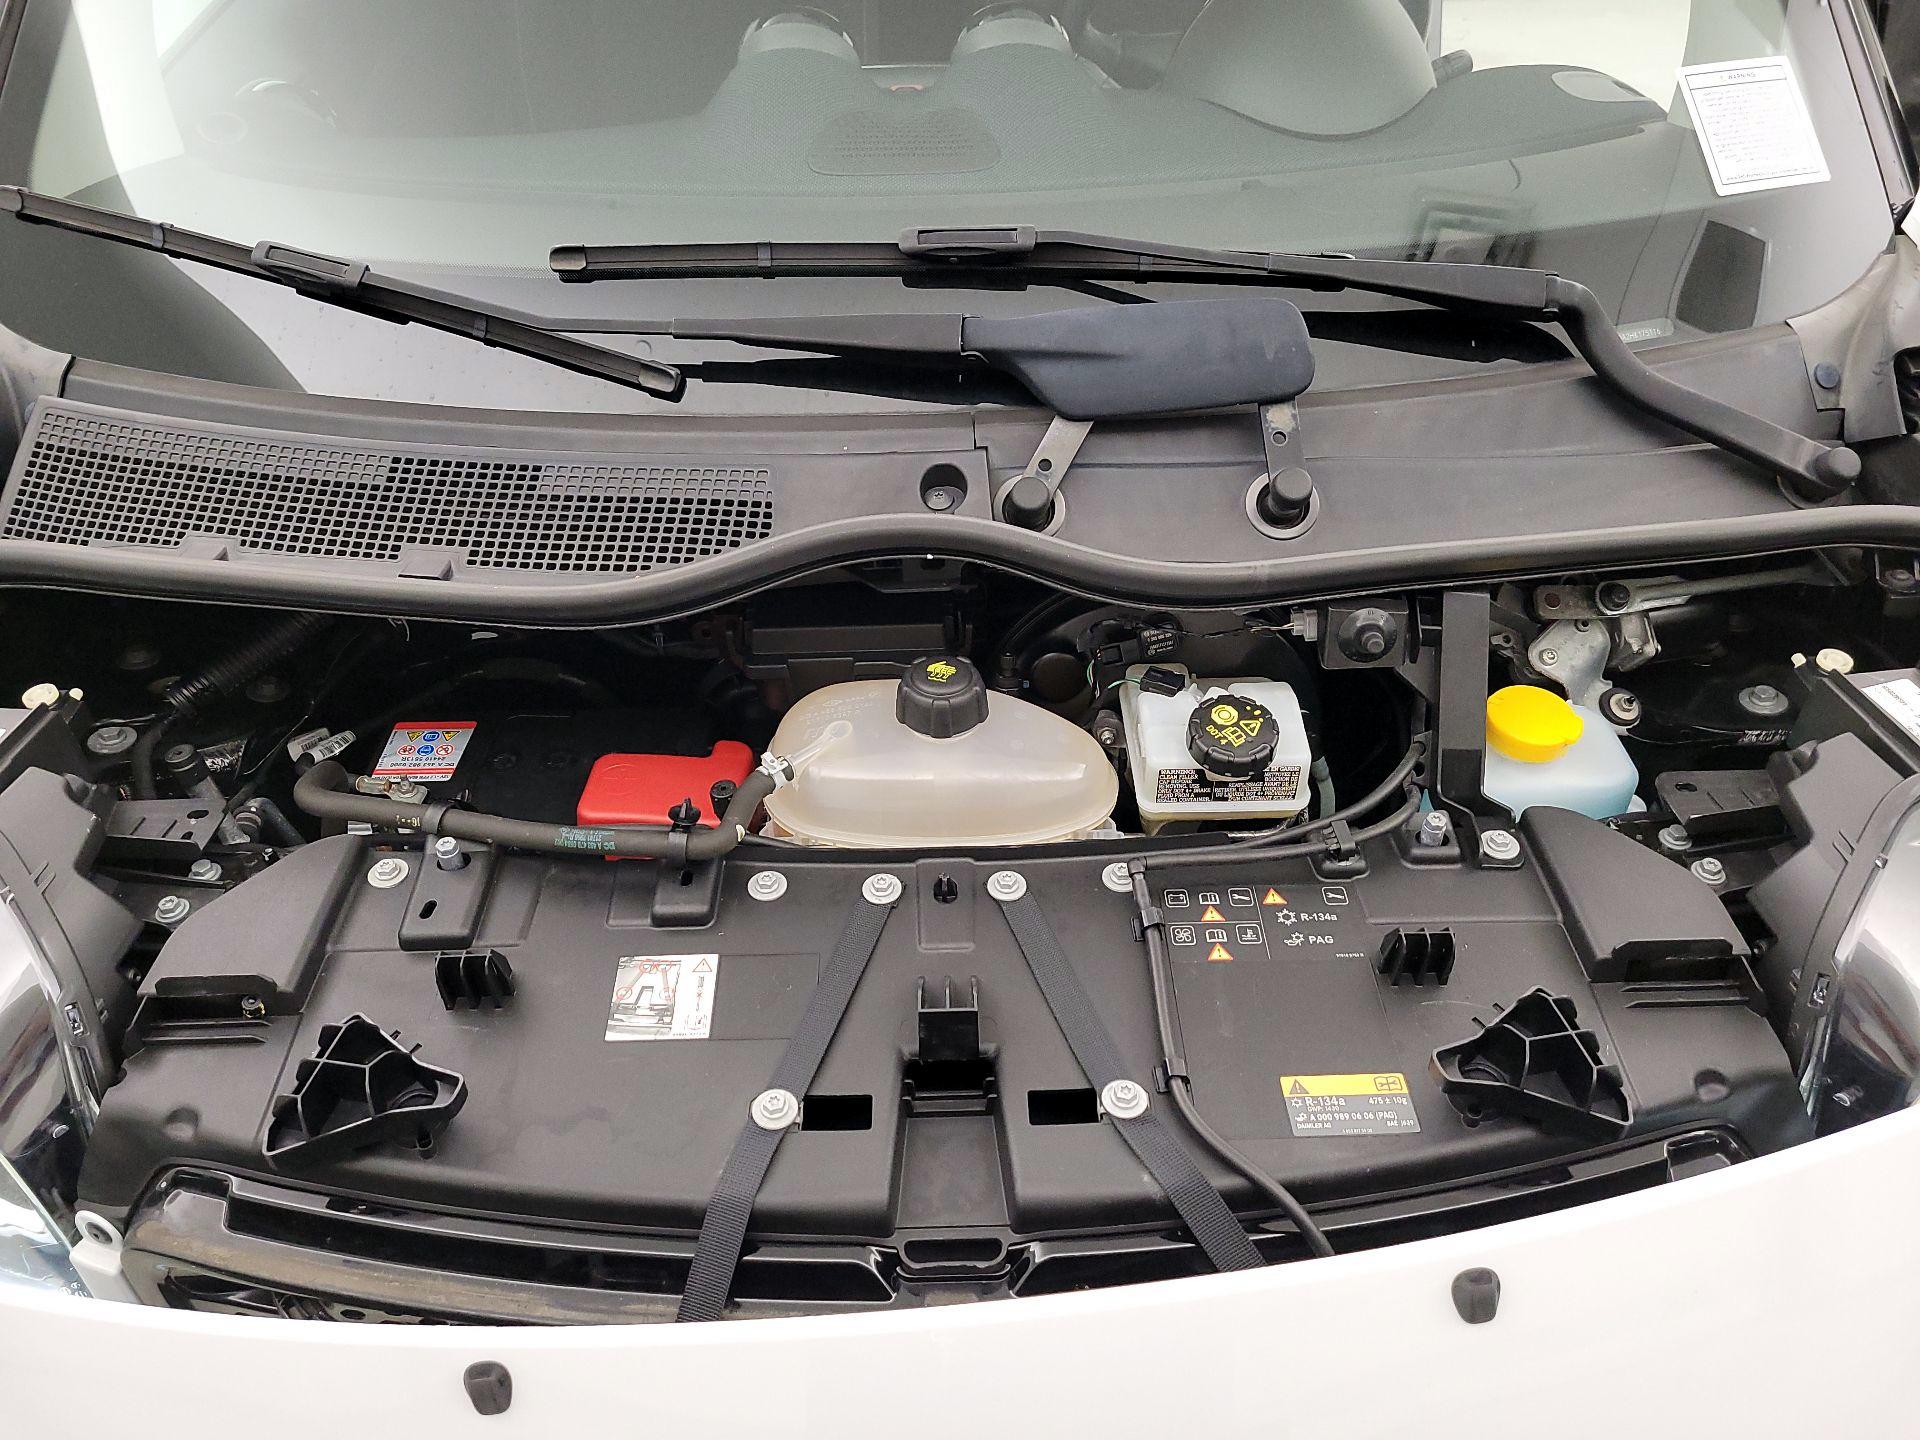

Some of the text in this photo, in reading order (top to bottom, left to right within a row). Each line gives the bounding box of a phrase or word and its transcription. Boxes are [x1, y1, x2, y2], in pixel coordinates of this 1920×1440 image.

[1205, 724, 1222, 740] DOT
[1300, 912, 1338, 921] R-134a
[1308, 935, 1334, 944] PAG
[1304, 1096, 1346, 1107] R-134a
[1368, 1097, 1383, 1105] 475
[1310, 1111, 1398, 1121] A 000 989 06 06 (PAG)
